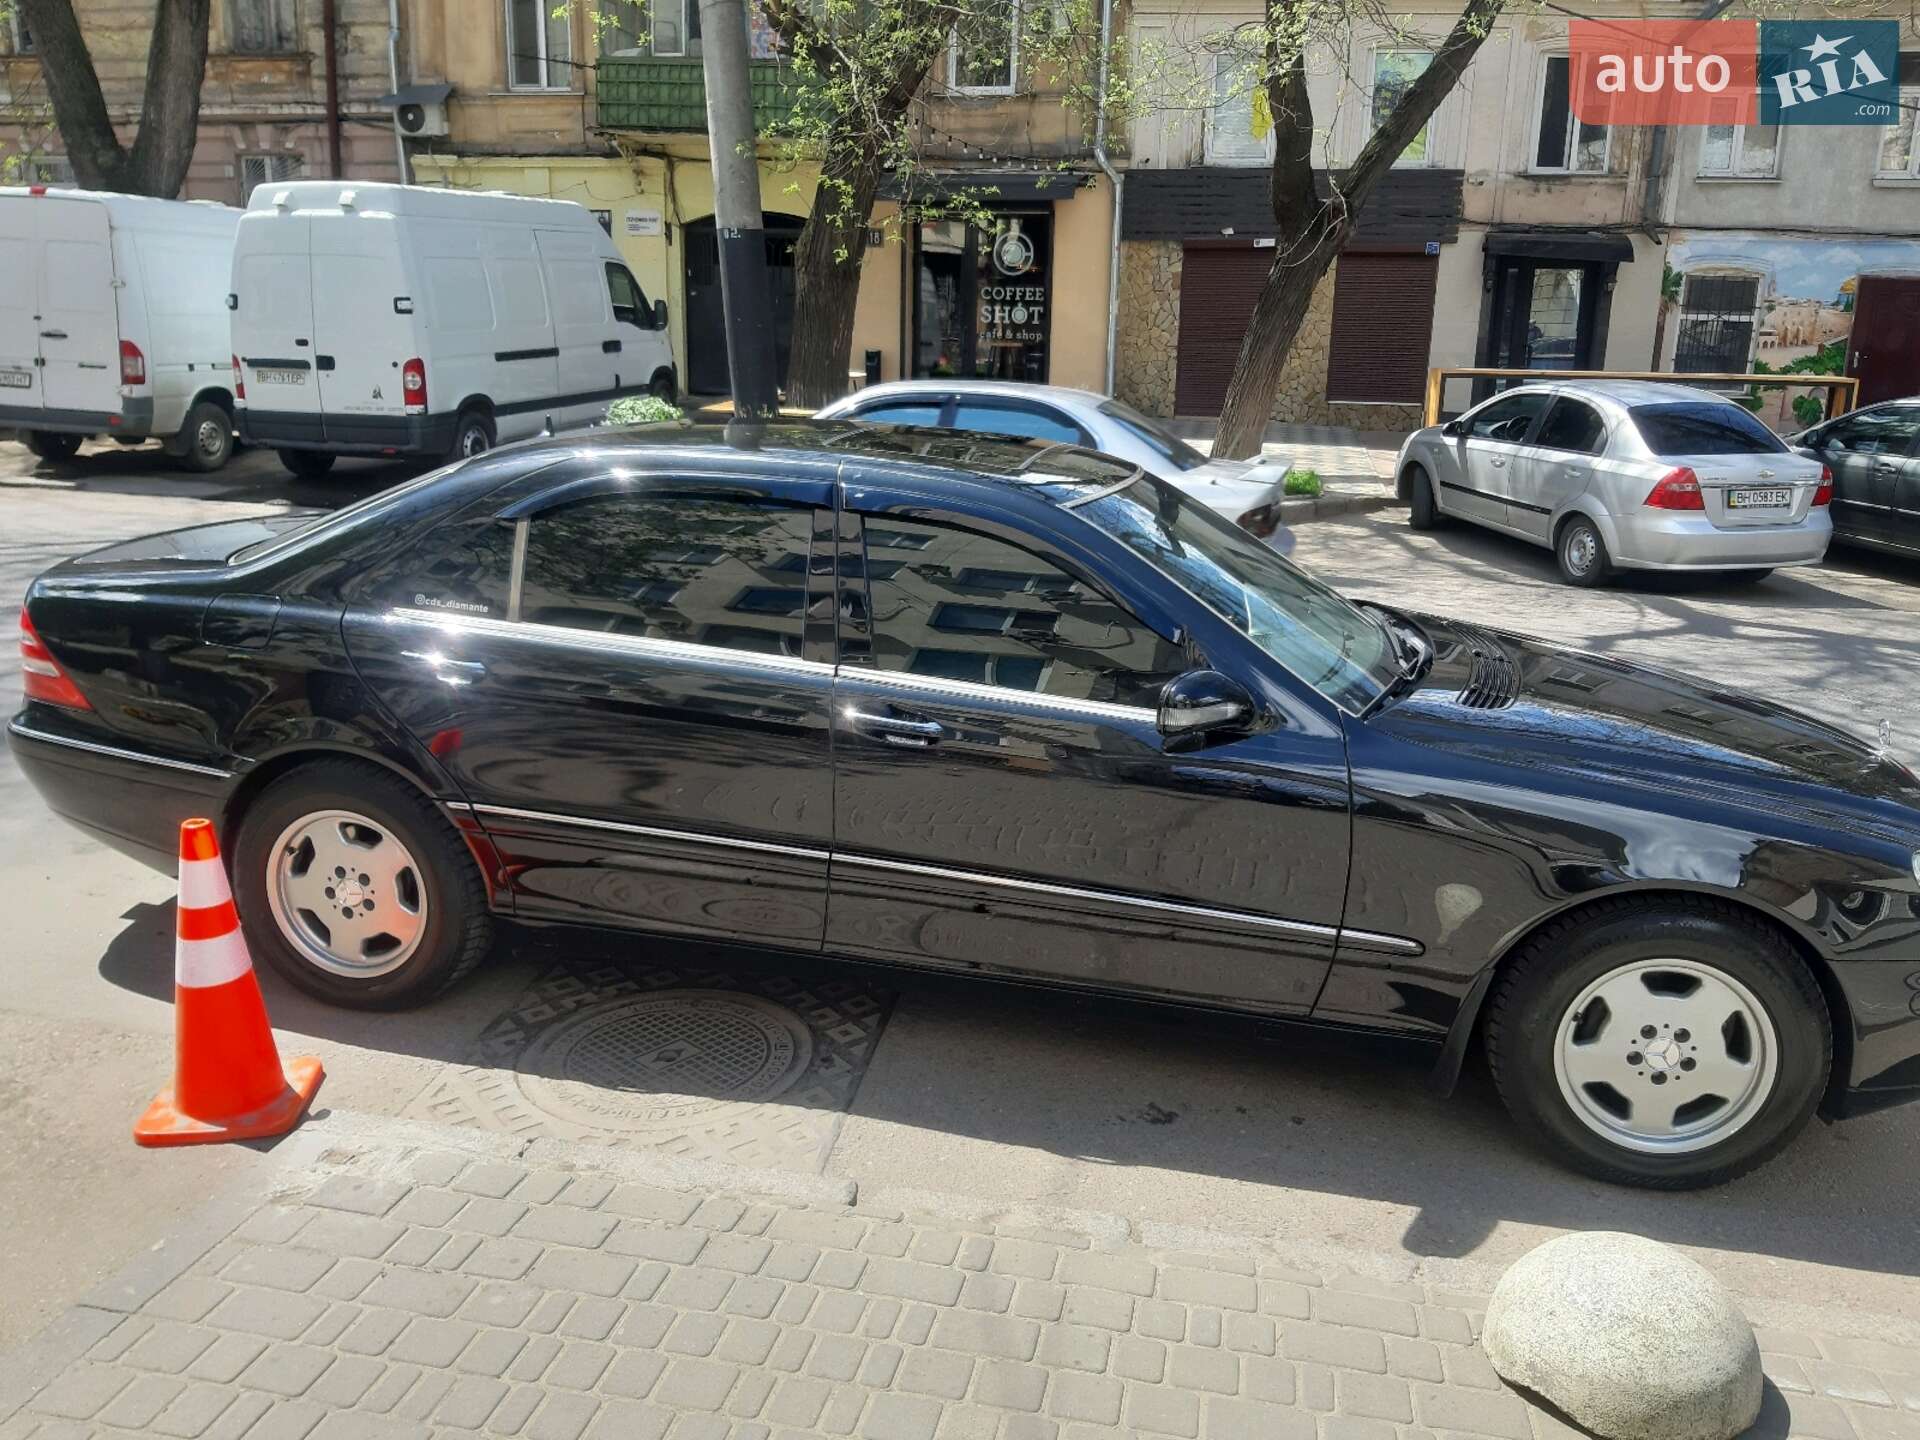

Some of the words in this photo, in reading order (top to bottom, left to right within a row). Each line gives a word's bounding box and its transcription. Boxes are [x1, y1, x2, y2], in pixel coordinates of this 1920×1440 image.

[980, 286, 1045, 301] COFFEE
[980, 302, 1044, 325] SHOT
[1005, 329, 1013, 339] &
[1016, 329, 1043, 344] shop
